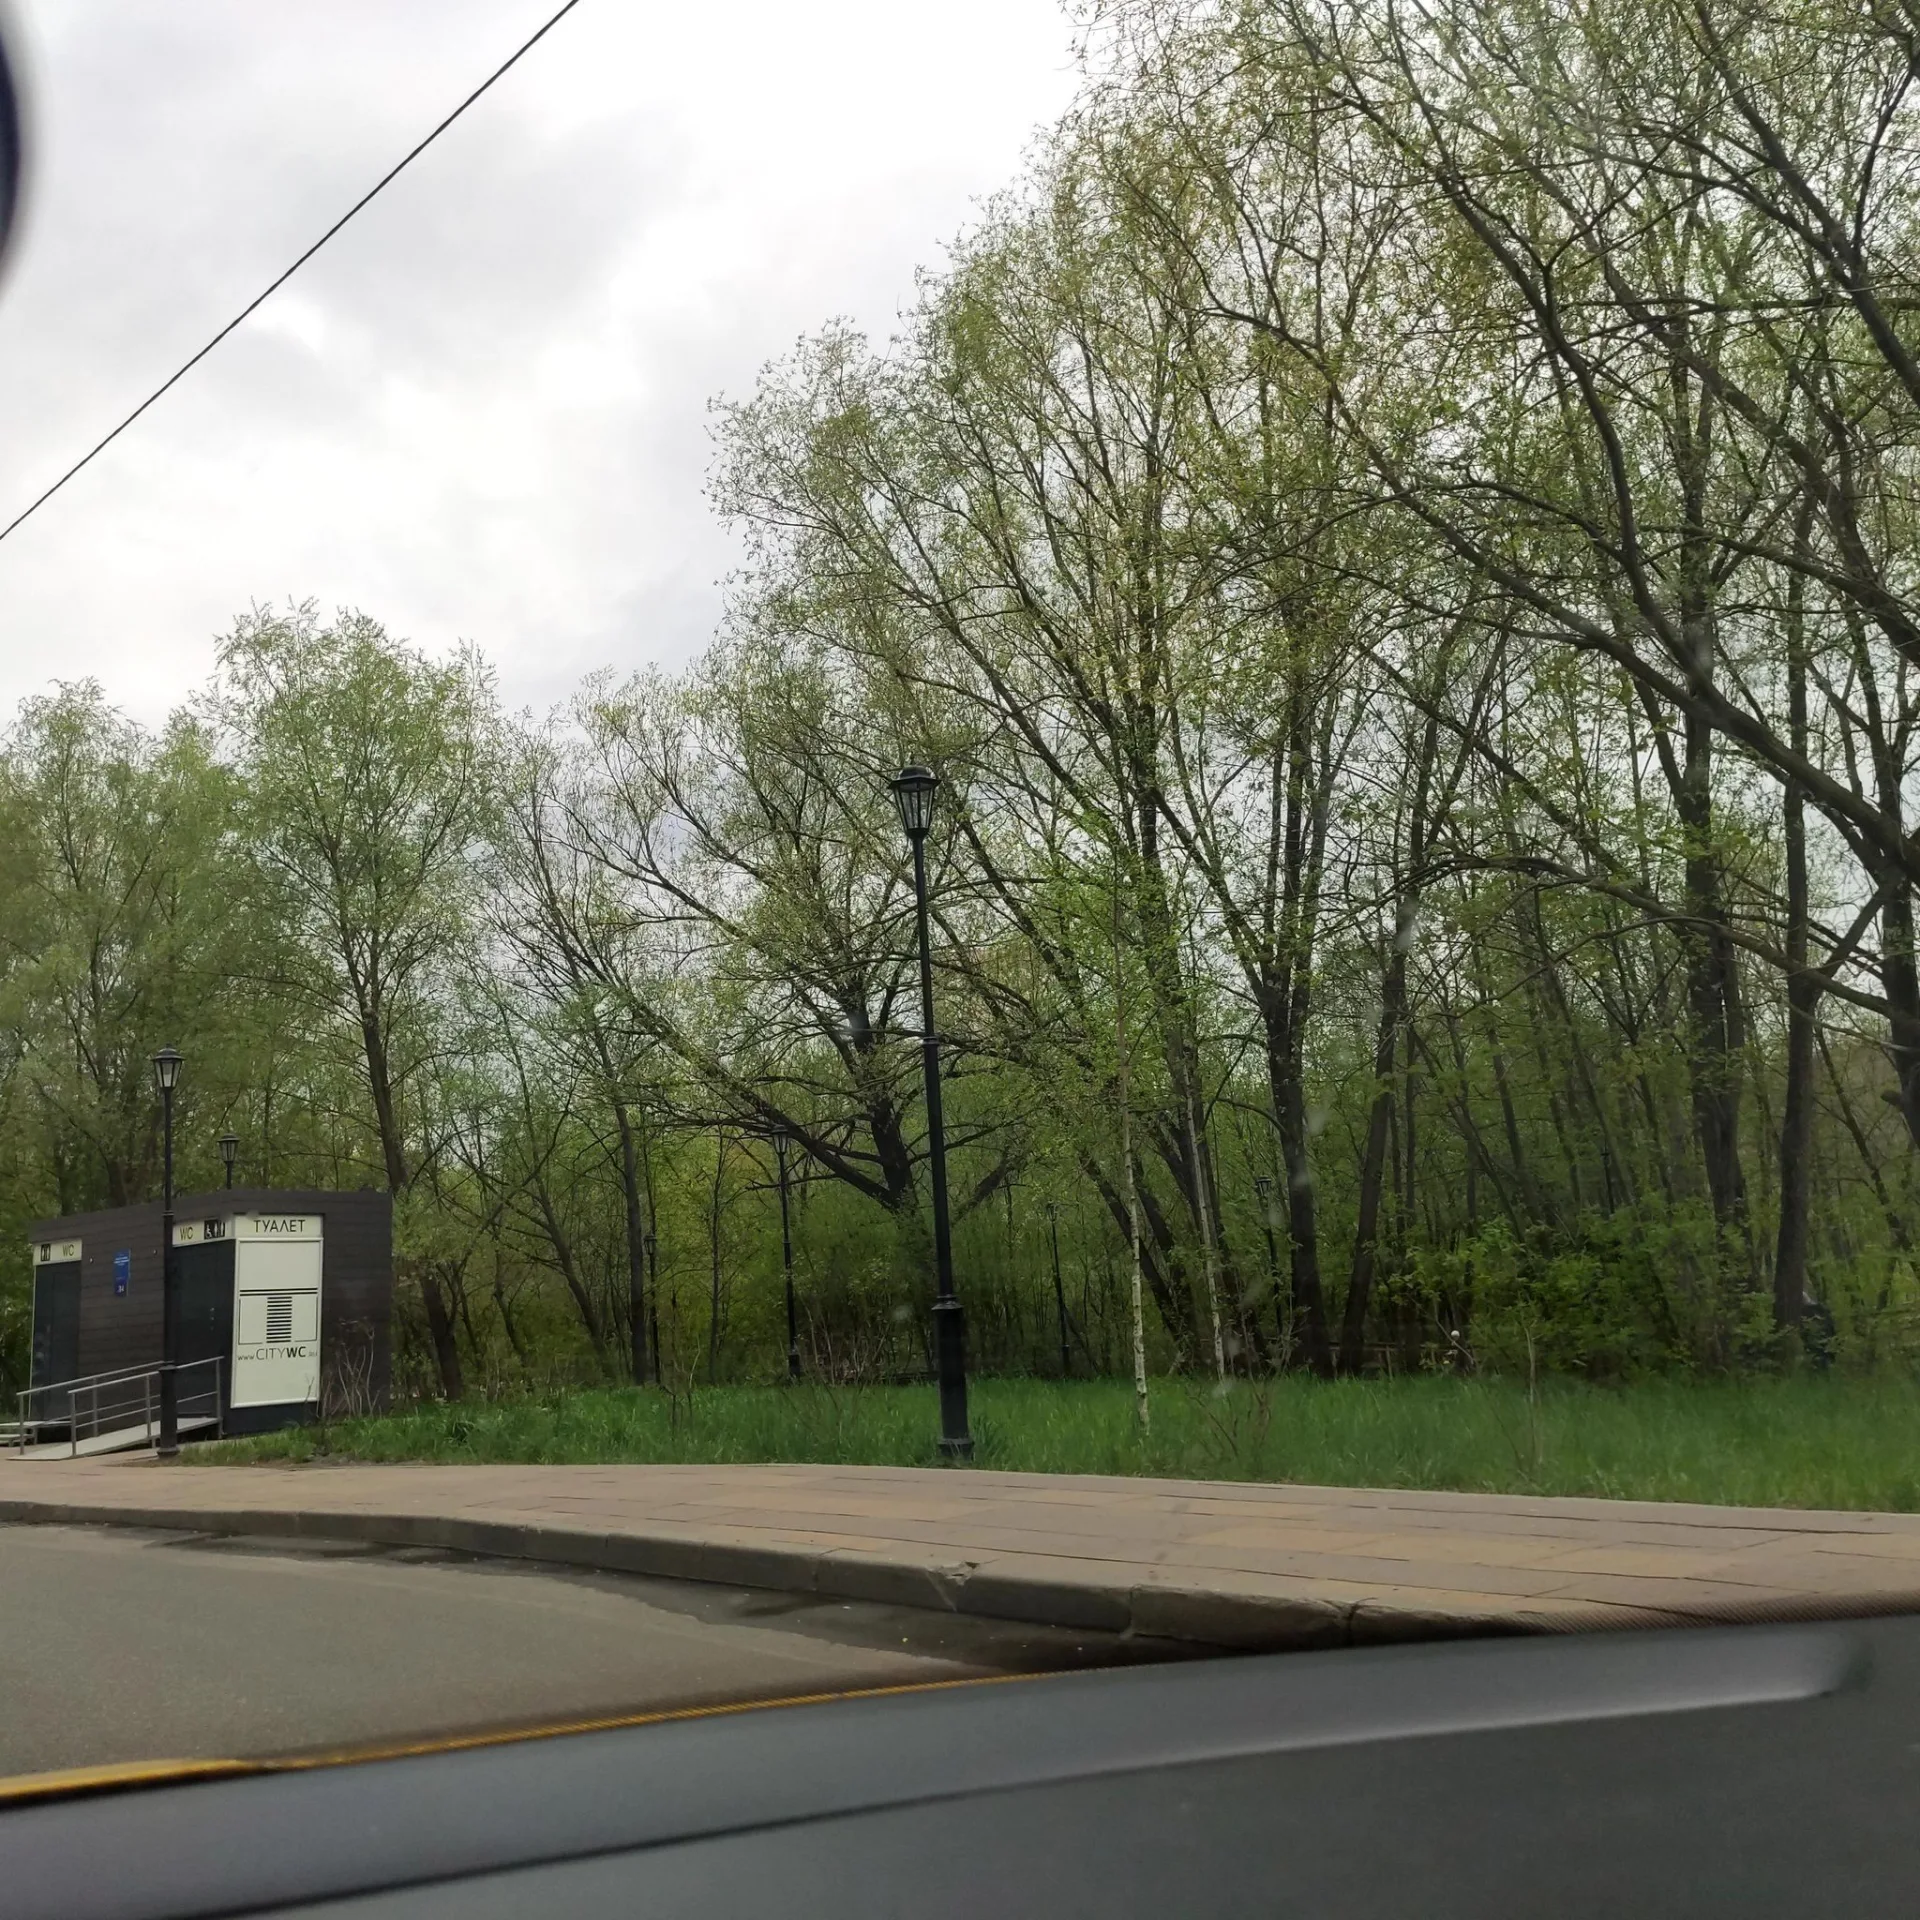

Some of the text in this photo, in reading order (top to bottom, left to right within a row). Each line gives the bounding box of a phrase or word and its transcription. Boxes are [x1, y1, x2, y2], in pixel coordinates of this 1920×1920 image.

[180, 1226, 194, 1240] WC
[254, 1219, 306, 1233] ТУАЛЕТ
[62, 1244, 75, 1256] WC
